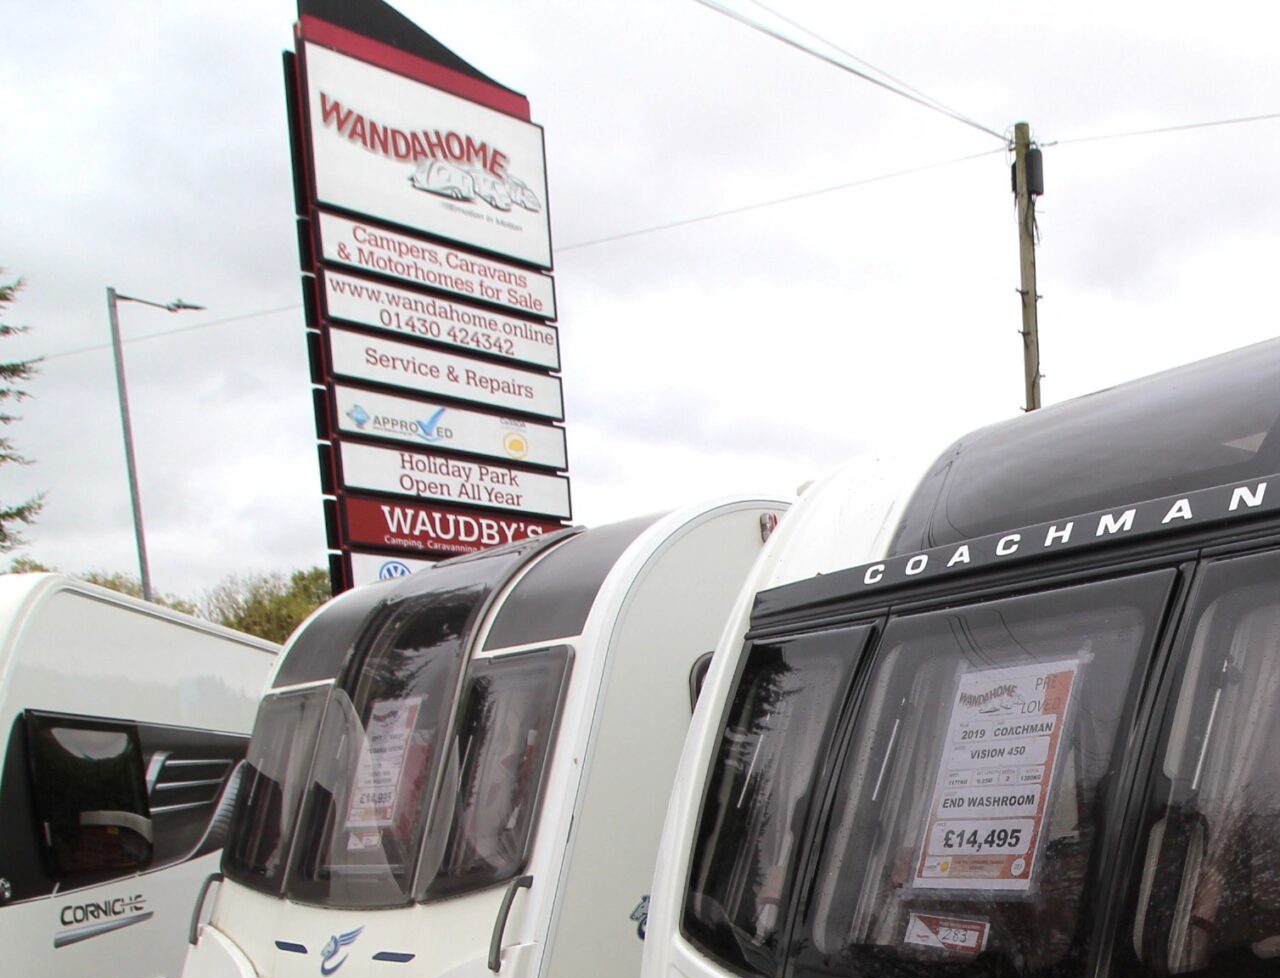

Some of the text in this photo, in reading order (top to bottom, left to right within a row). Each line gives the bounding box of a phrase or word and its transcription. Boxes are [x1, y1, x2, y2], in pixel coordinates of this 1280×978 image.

[320, 91, 508, 178] WANDAHOME
[337, 241, 543, 312] & Motorhomes for Sale
[352, 226, 528, 288] Campers, Caravans
[329, 277, 554, 346] www.wandahome.online
[379, 308, 515, 357] 01430 424342
[365, 347, 534, 400] Service & Repairs
[400, 453, 519, 486] Holiday Park
[400, 474, 523, 506] Open All Year
[863, 482, 1267, 585] COACHMAN
[960, 685, 1017, 707] WANDAHOME
[961, 722, 1054, 740] 2019 COACHMAN
[970, 746, 1026, 759] VISION 450
[942, 795, 1035, 808] END WASHROOM
[943, 829, 1022, 852] £14,495
